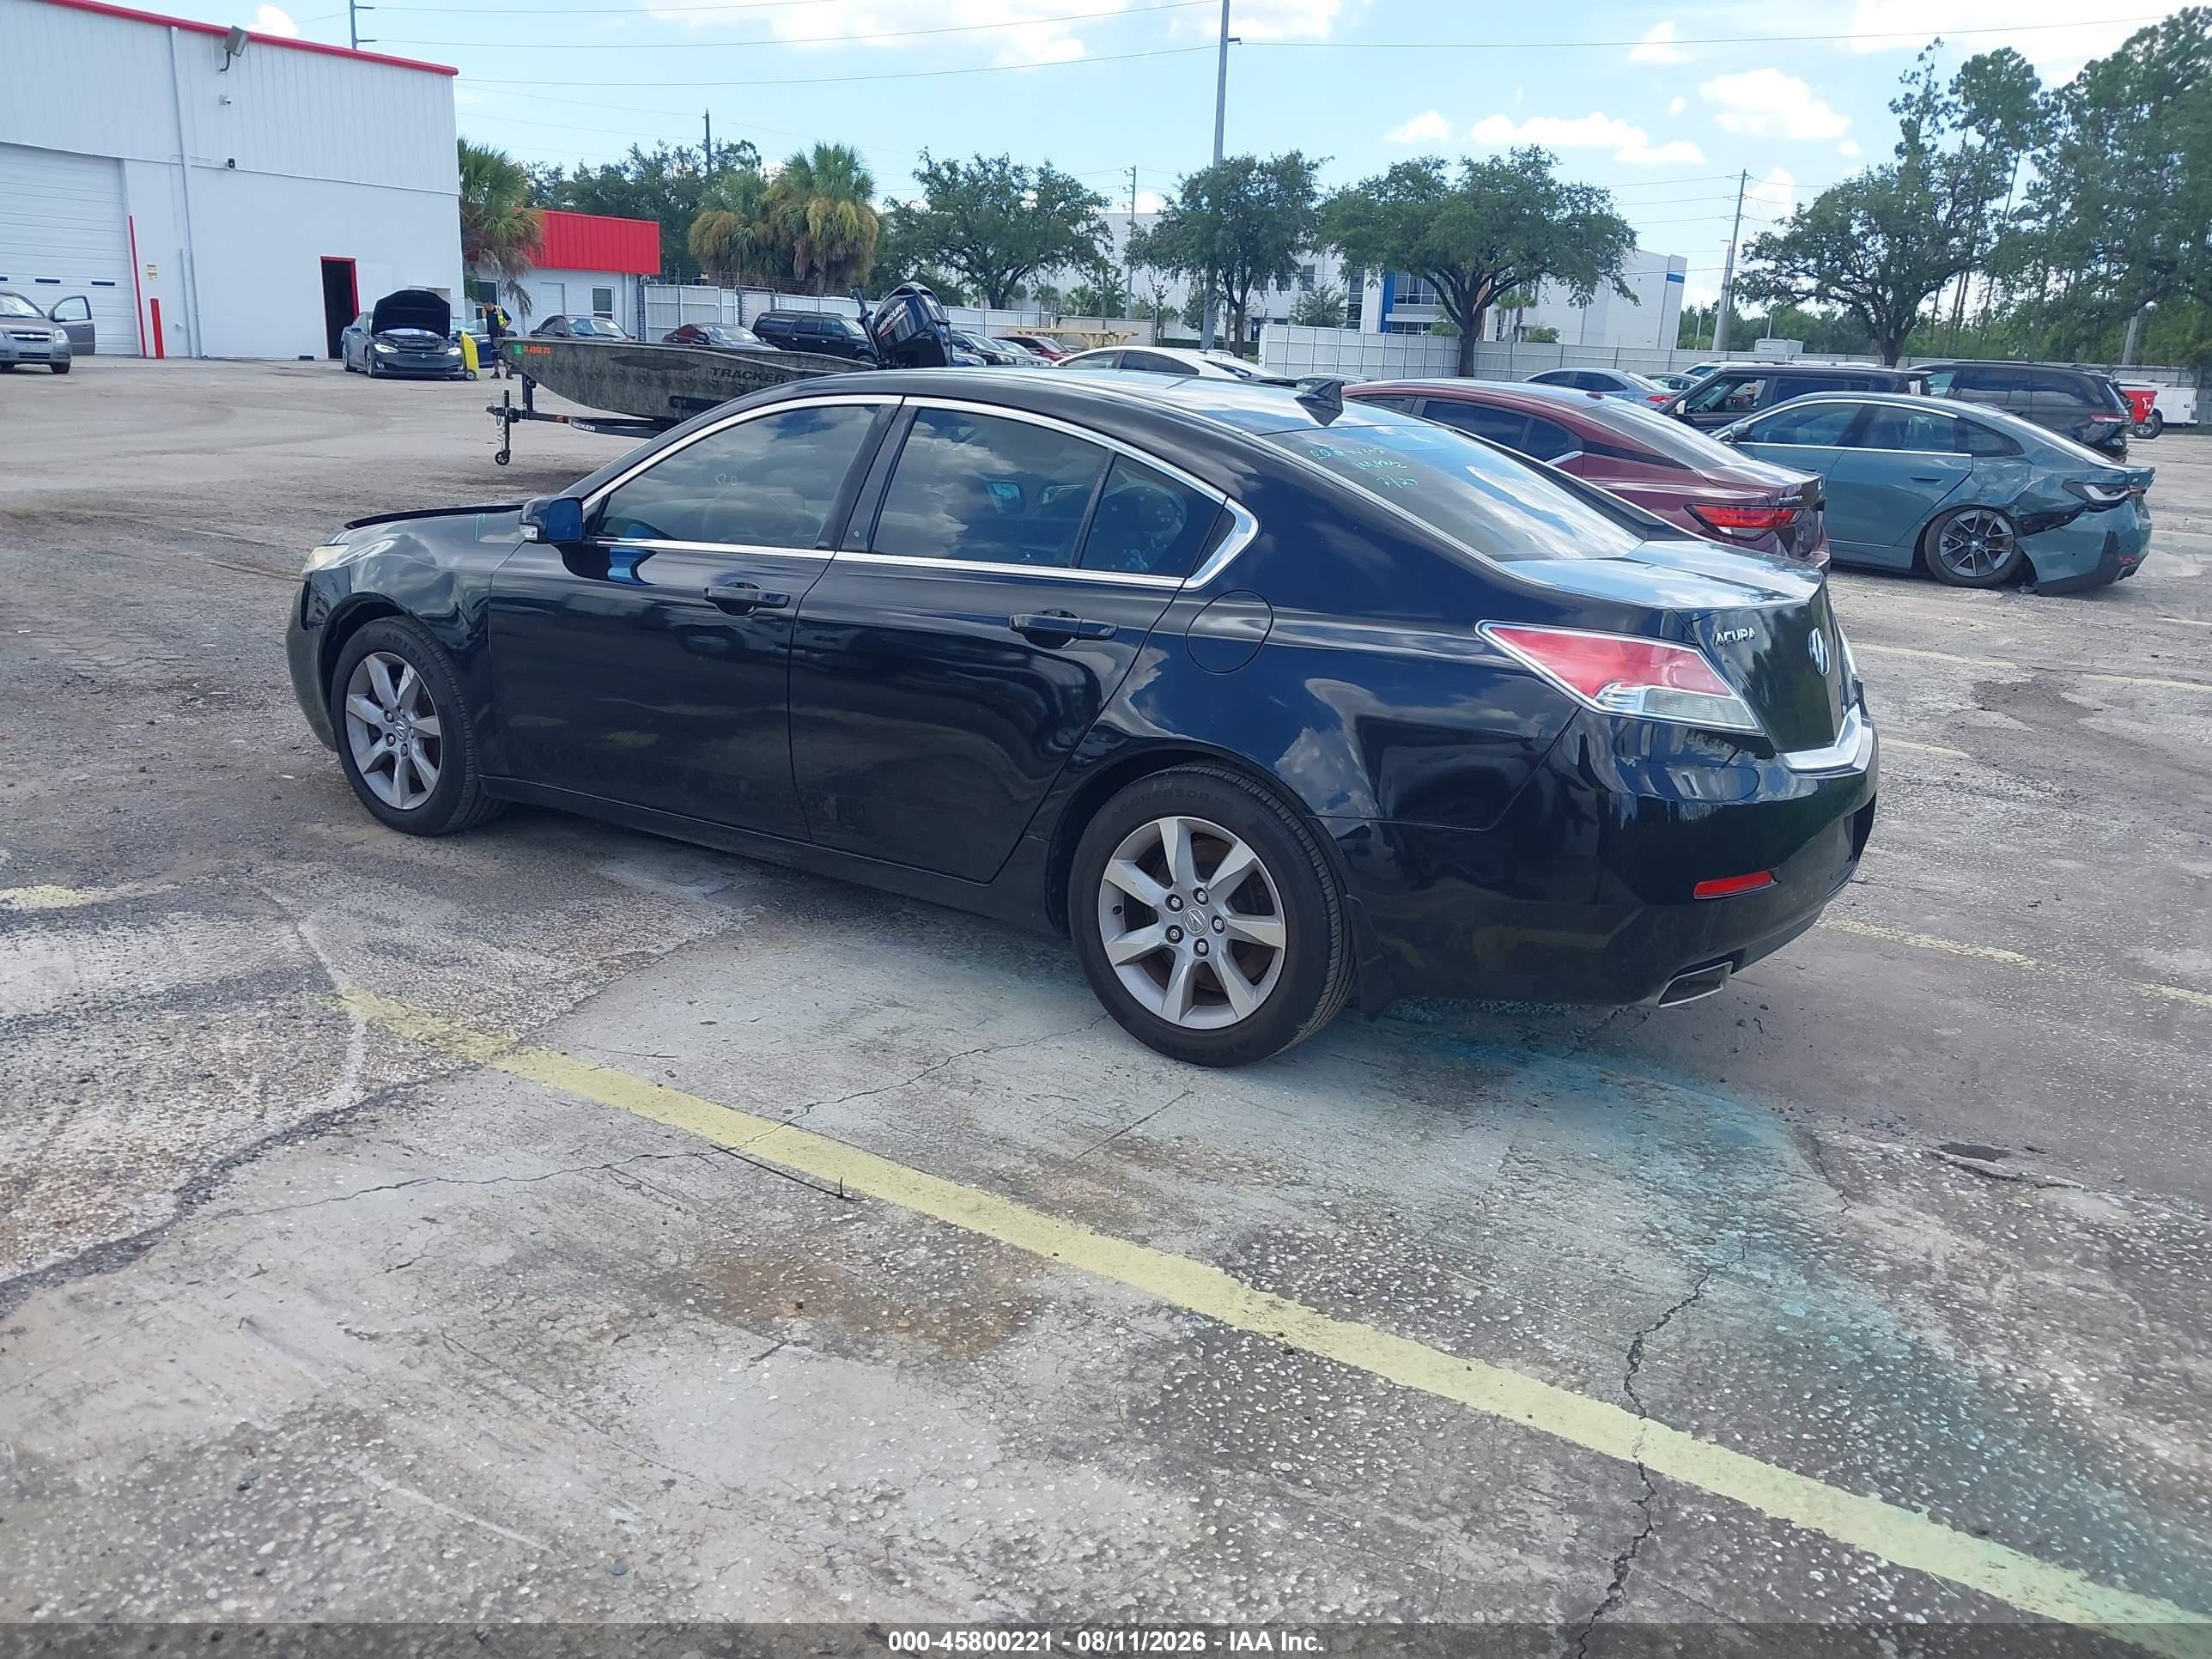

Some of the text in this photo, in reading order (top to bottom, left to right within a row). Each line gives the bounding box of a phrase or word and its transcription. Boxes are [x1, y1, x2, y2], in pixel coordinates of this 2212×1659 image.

[878, 300, 907, 335] MERCURY
[709, 367, 786, 384] TRACKER
[1714, 627, 1756, 646] ACURA
